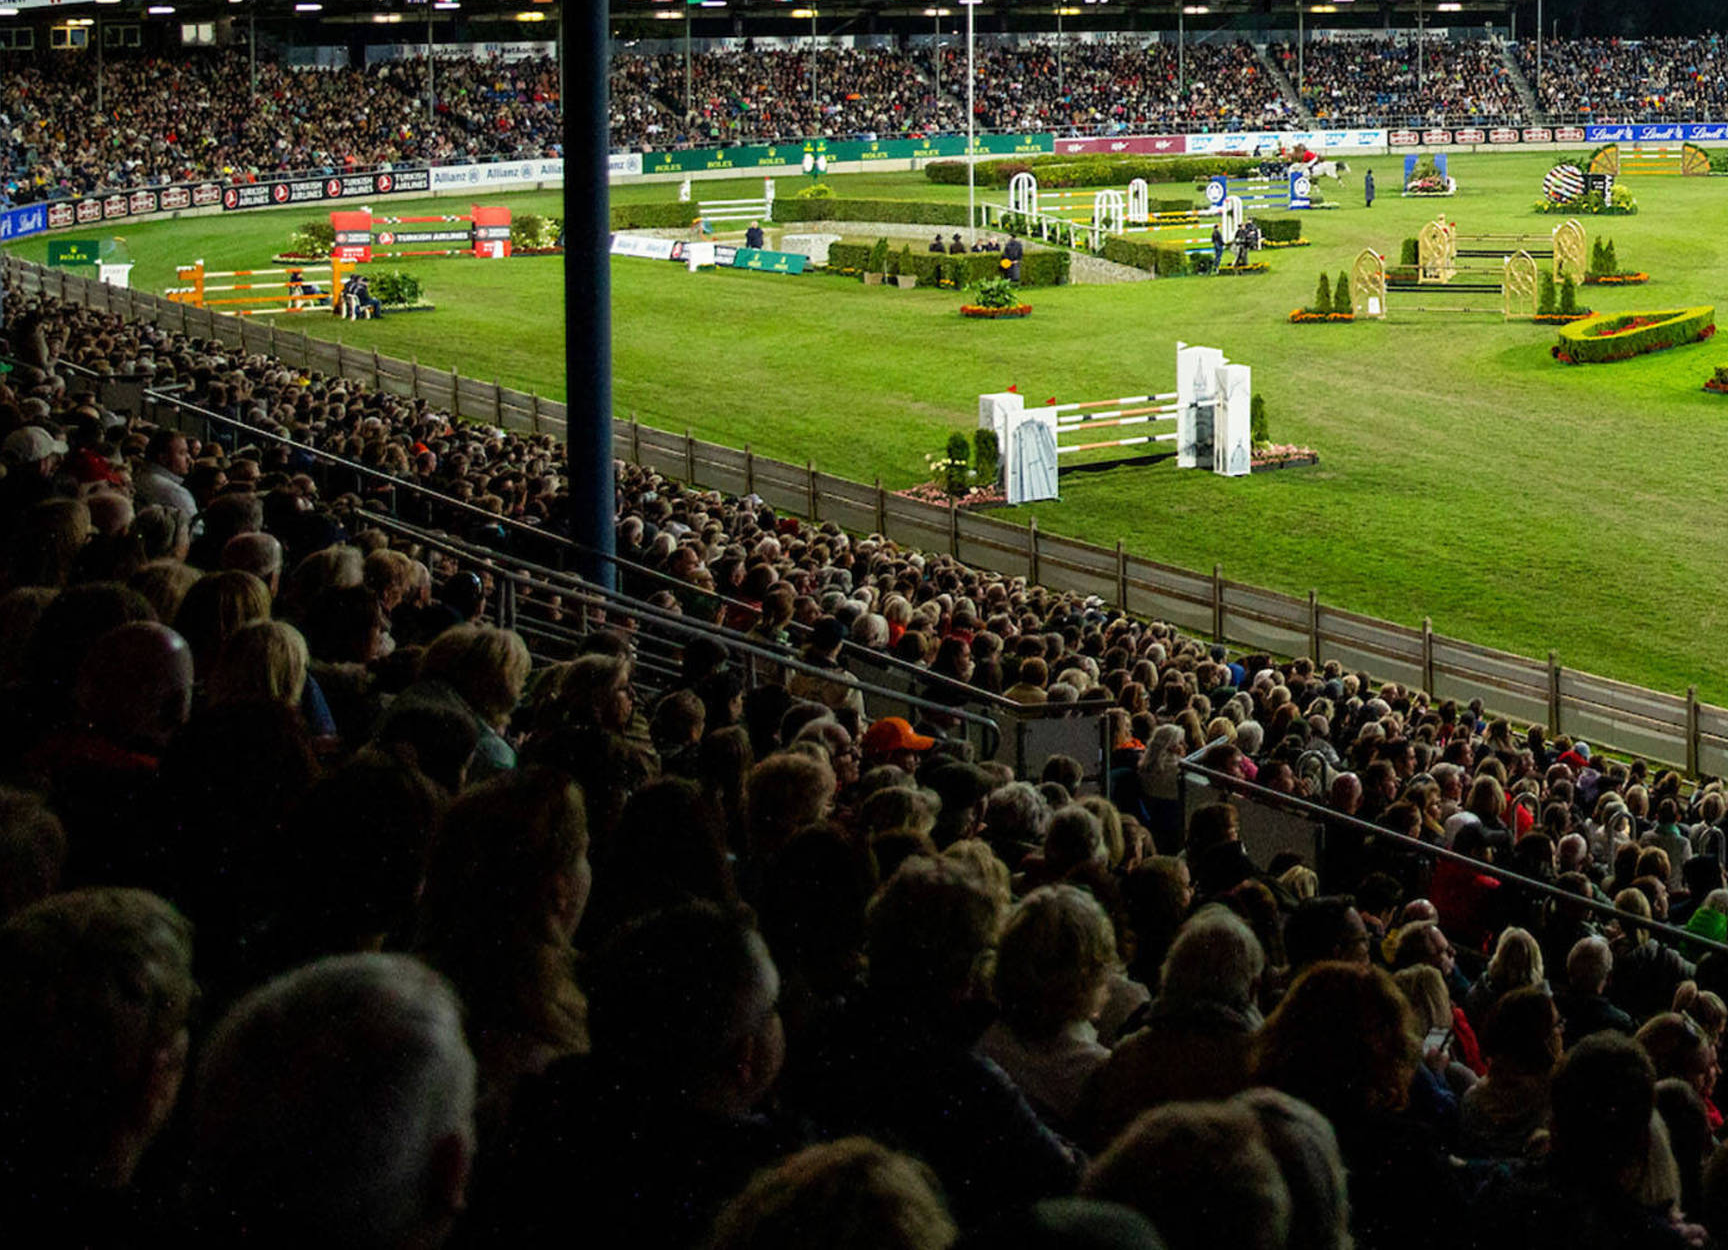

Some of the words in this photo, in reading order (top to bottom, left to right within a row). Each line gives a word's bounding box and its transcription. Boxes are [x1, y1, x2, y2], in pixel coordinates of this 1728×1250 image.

[1590, 126, 1626, 140] Lindt
[1639, 126, 1675, 140] Lindt
[1689, 126, 1726, 140] Lindt
[434, 173, 466, 183] Allianz
[487, 168, 518, 178] Allianz
